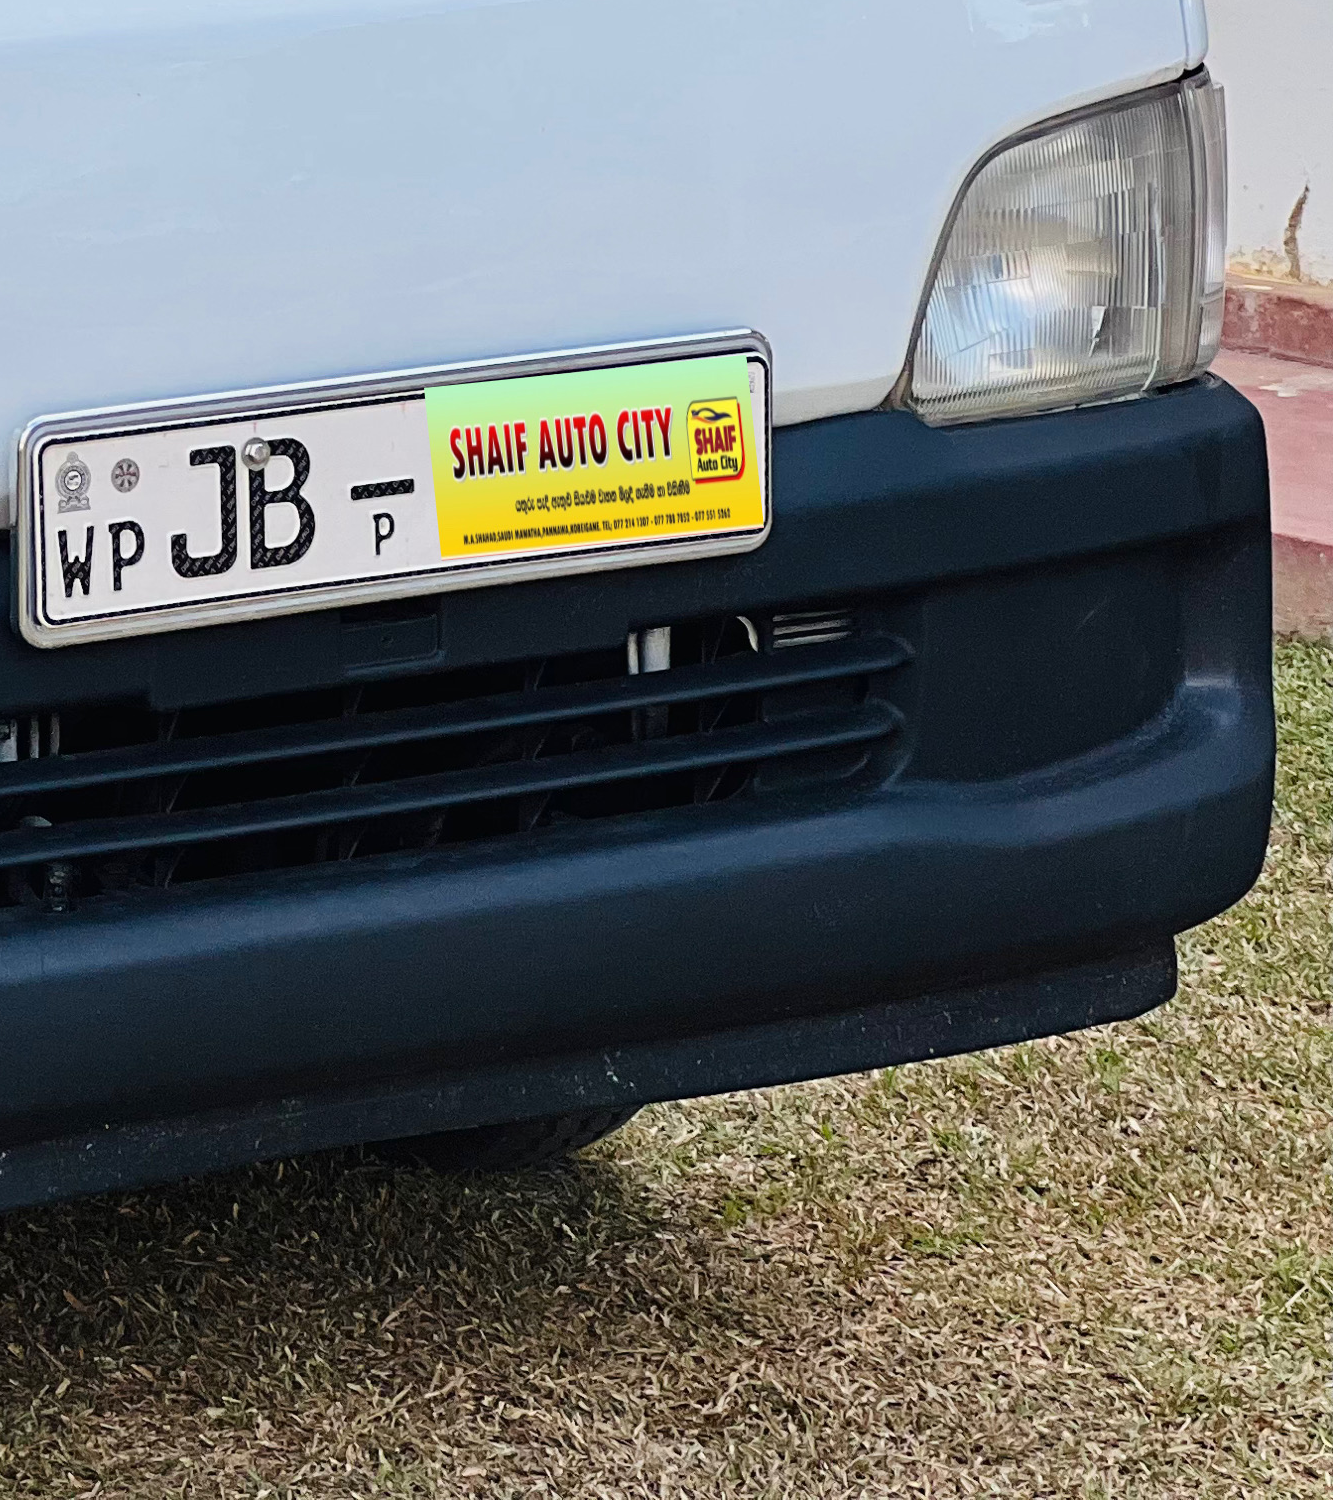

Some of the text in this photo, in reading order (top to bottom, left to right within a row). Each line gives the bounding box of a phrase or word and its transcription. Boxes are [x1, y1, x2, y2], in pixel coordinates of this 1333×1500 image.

[171, 438, 317, 578] JB
[372, 512, 396, 556] P
[58, 522, 146, 598] WP
